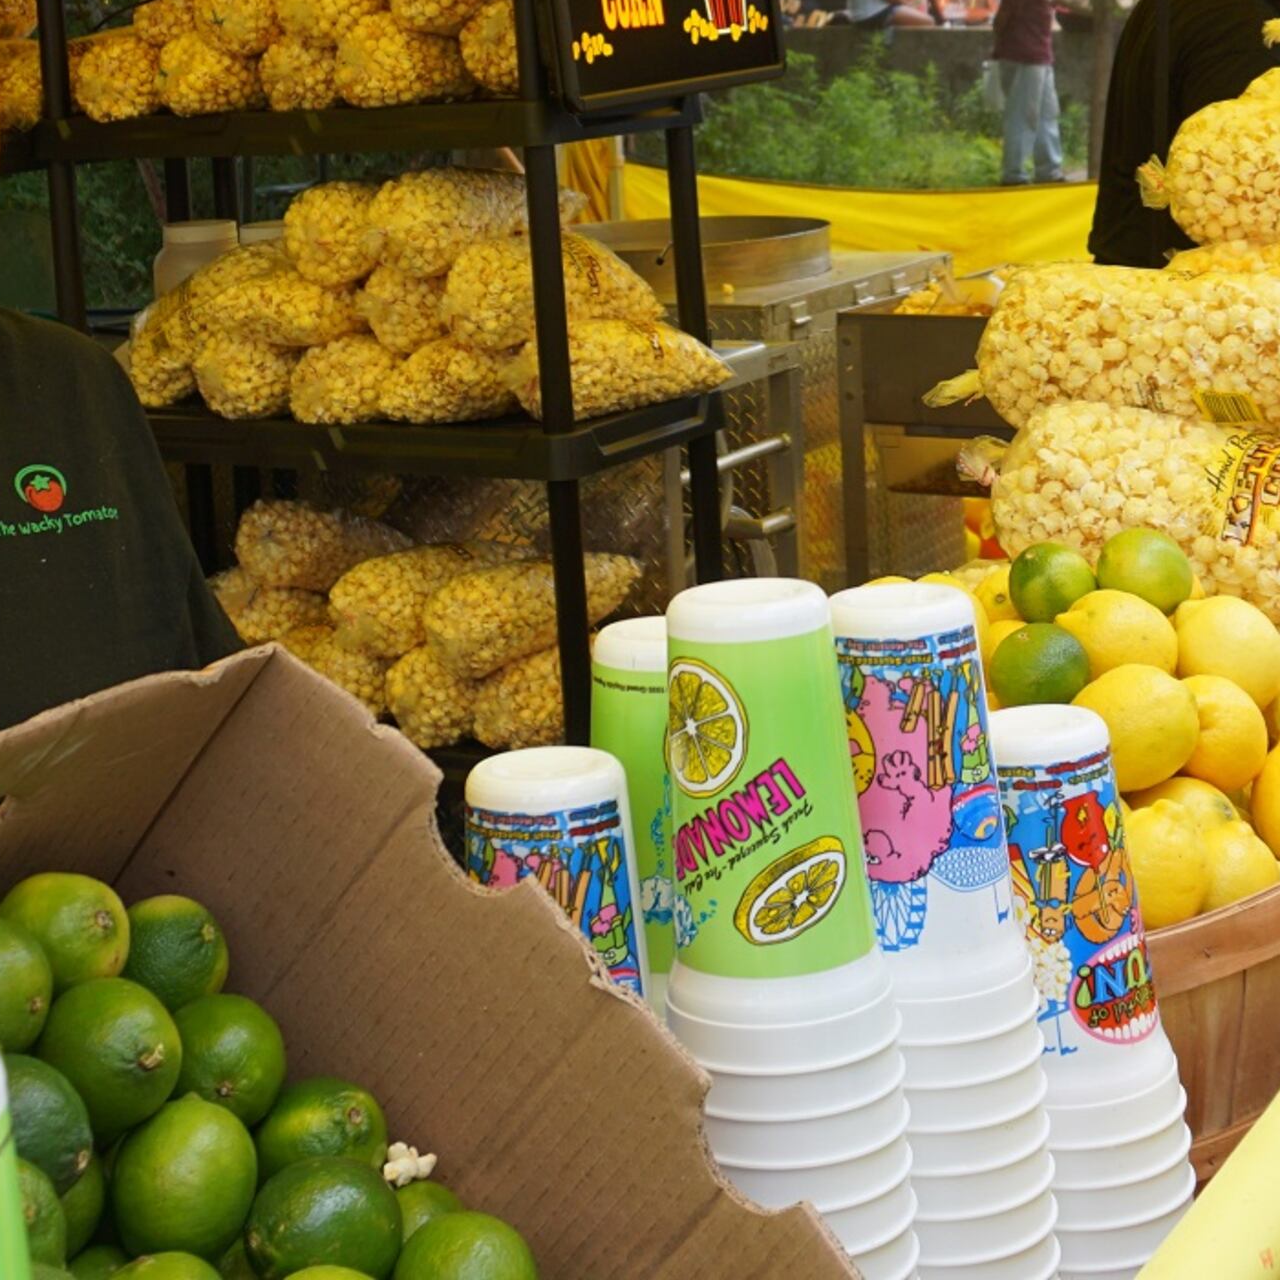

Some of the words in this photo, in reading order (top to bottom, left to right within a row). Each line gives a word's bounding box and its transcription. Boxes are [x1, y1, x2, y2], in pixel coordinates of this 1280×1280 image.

[63, 505, 119, 526] Tomato
[1221, 440, 1276, 547] KETT
[672, 756, 807, 882] LEMONAD
[781, 798, 814, 834] Fresh
[1074, 948, 1152, 1009] UN!
